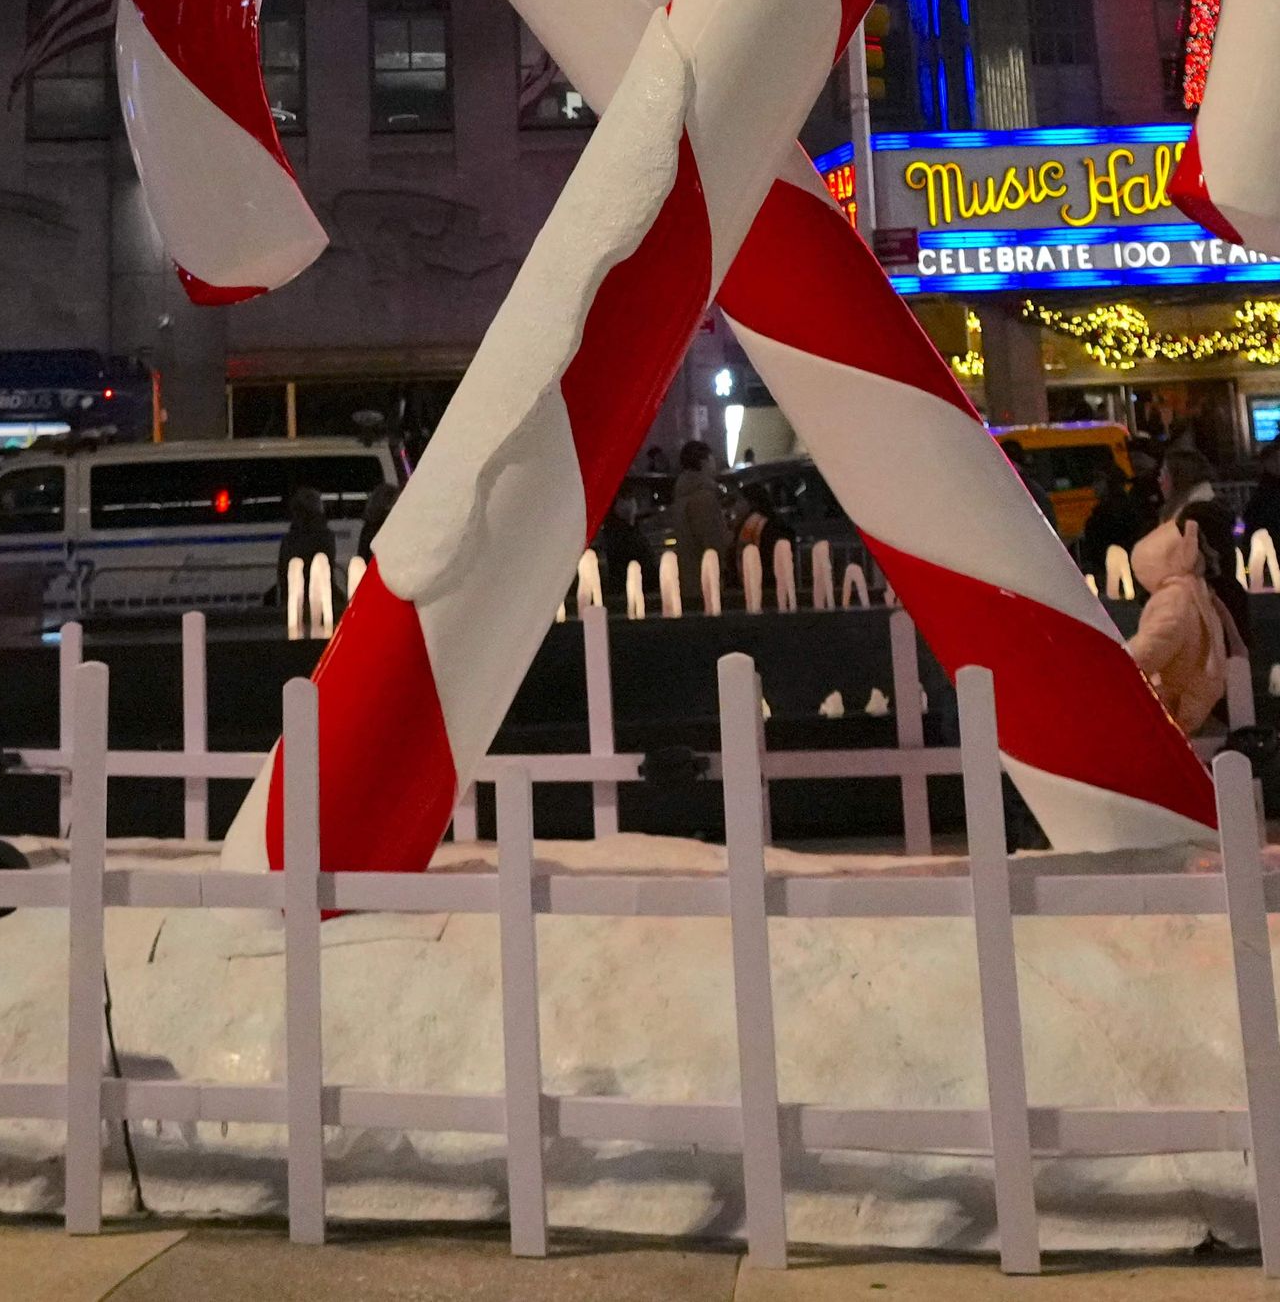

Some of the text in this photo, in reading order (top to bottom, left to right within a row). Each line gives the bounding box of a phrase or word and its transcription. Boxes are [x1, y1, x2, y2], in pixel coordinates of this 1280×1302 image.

[904, 141, 1186, 227] Music Hal
[918, 244, 1093, 276] CELEBRATE
[1114, 241, 1171, 268] 100
